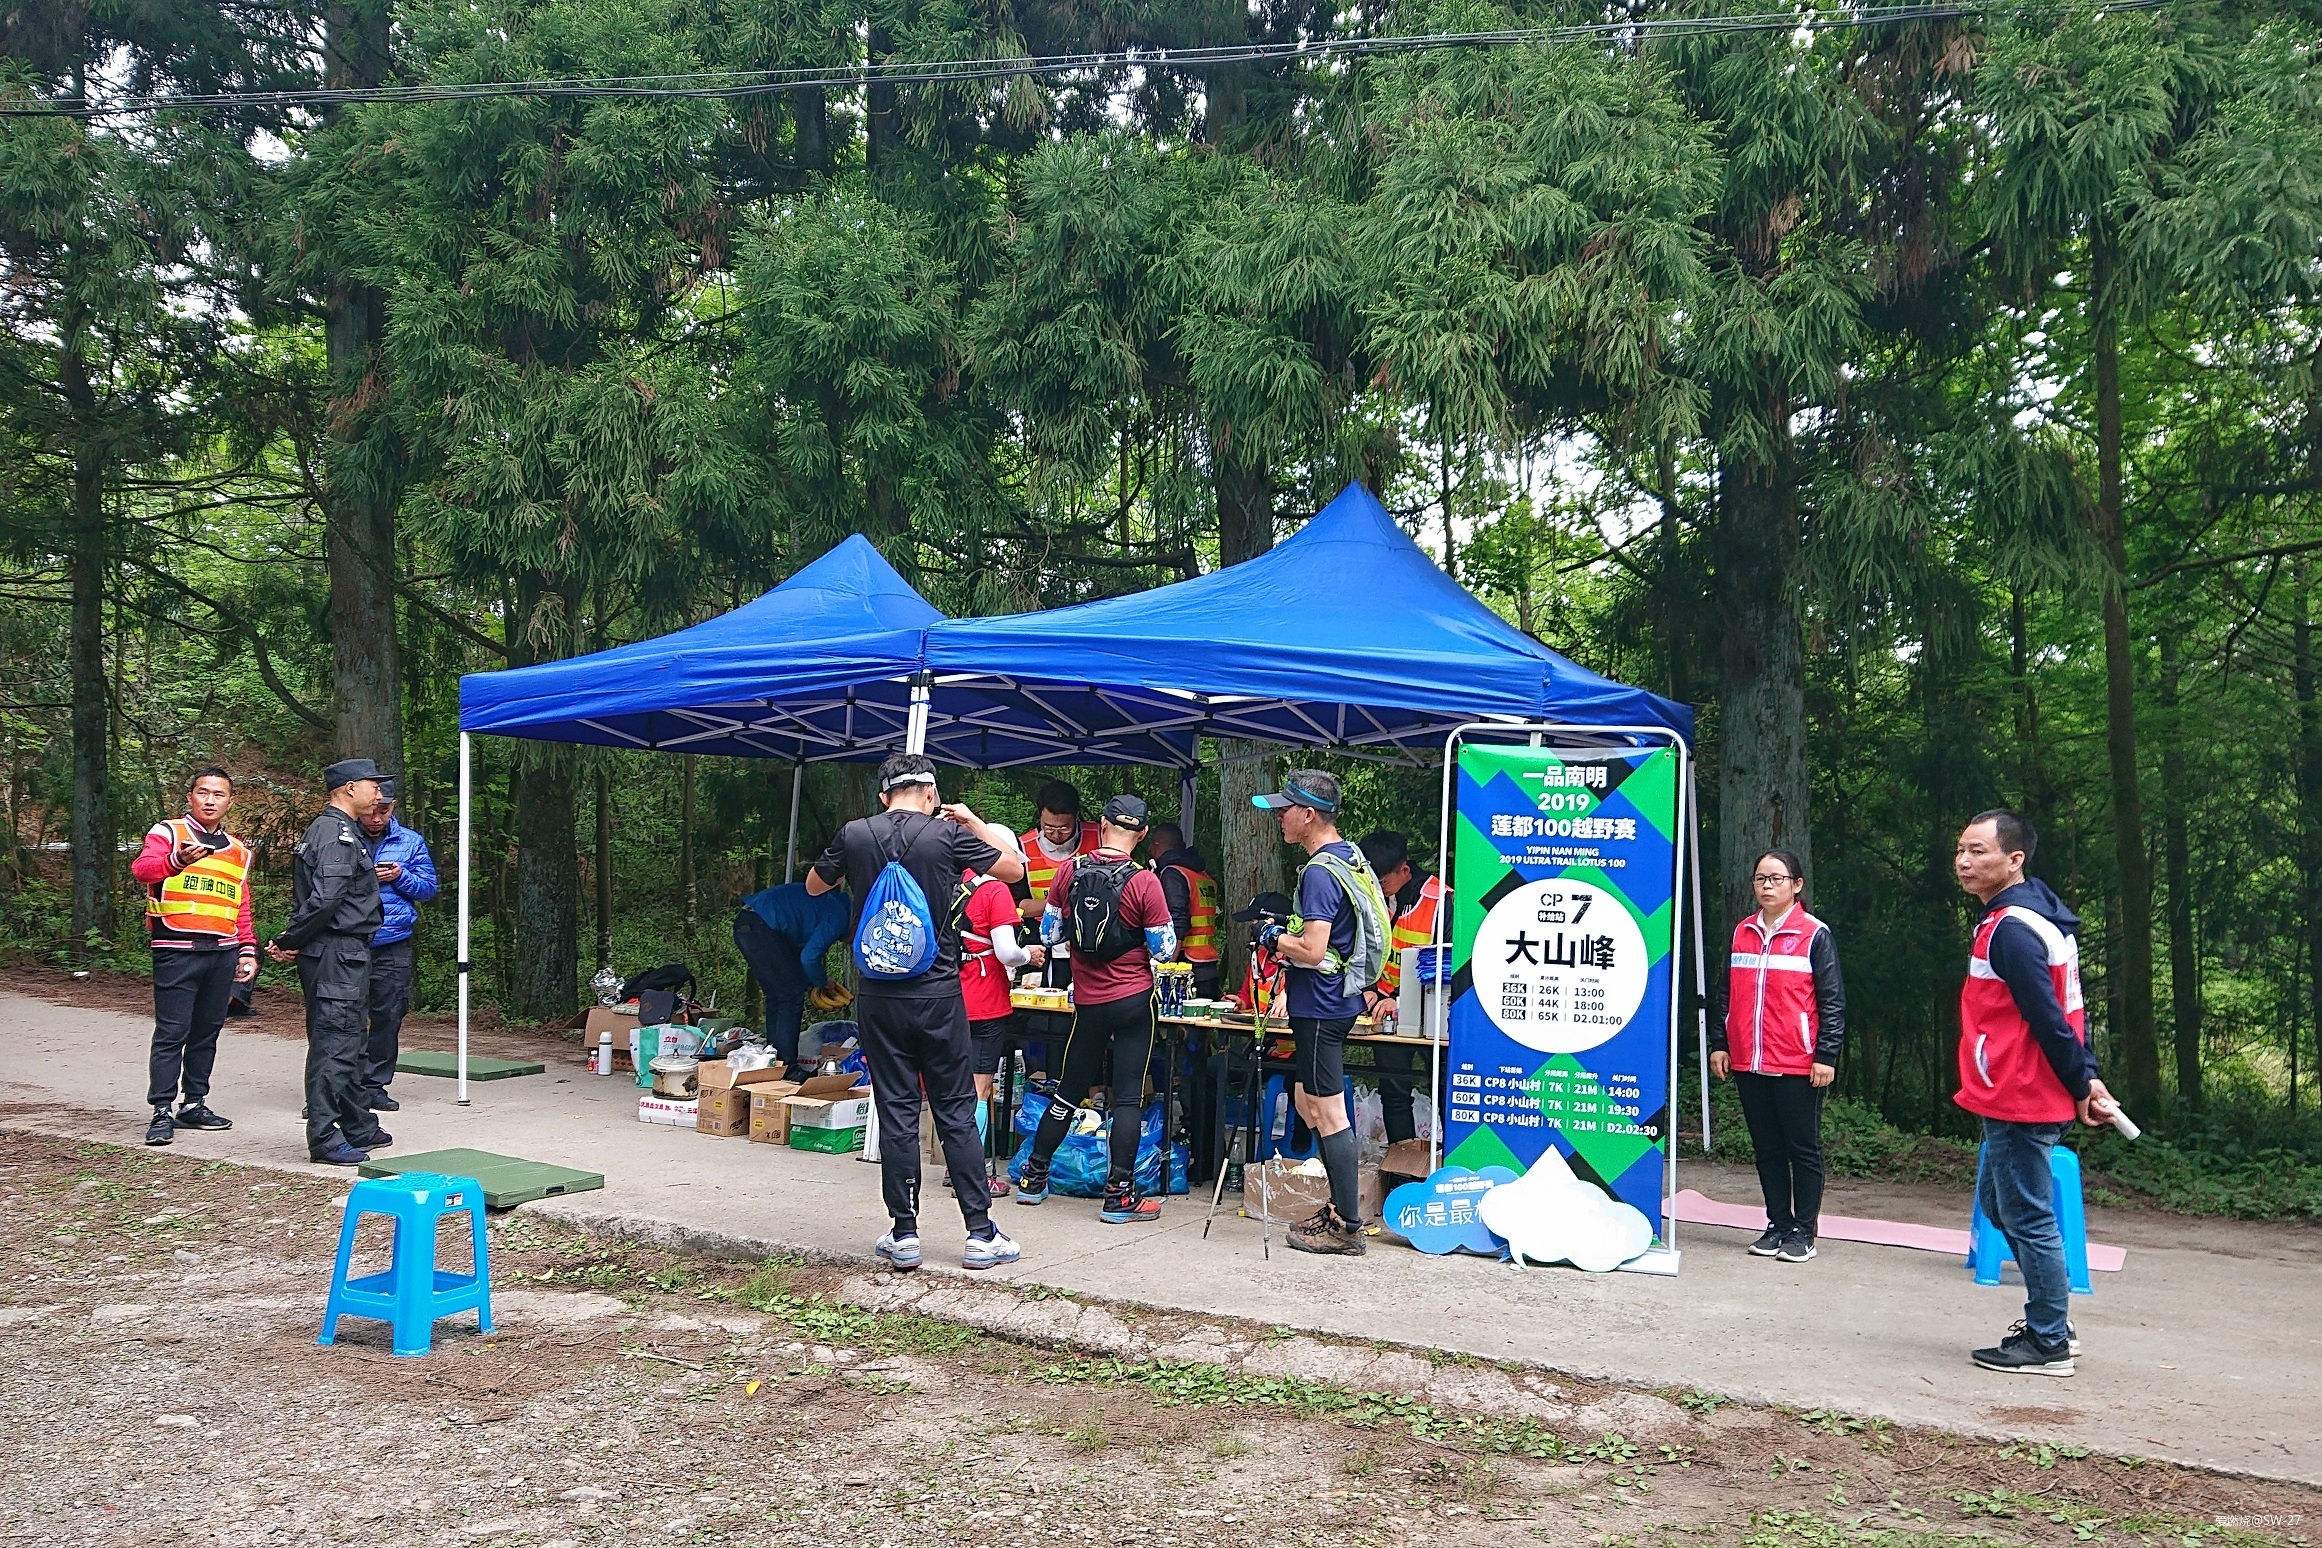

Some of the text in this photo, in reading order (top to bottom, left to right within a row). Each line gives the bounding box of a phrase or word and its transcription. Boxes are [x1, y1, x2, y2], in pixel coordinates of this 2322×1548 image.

[1523, 766, 1607, 788] 一品南明
[1538, 793, 1590, 811] 2019
[1491, 814, 1636, 840] 莲都100越野赛
[1499, 855, 1625, 868] 2019 ULTRA TRAIL LOTUS 100
[1526, 846, 1599, 857] YIPIN NAN MING
[1540, 893, 1563, 906] CP
[1571, 894, 1592, 924] 7
[1505, 930, 1616, 970] 大山峰
[1503, 983, 1605, 998] 36K 26K 13:00
[1503, 996, 1604, 1011] 60K 44K 18:00
[1502, 1009, 1623, 1025] 80K 65K D2.01:00
[1456, 1075, 1640, 1099] 36K CP8 小山村 7K 21M 14:00
[1455, 1093, 1639, 1117] 60K CP8 小山村 7K 21M 19:30
[1454, 1110, 1658, 1137] 80K CP8 小山村 7K 21M D2.02:30
